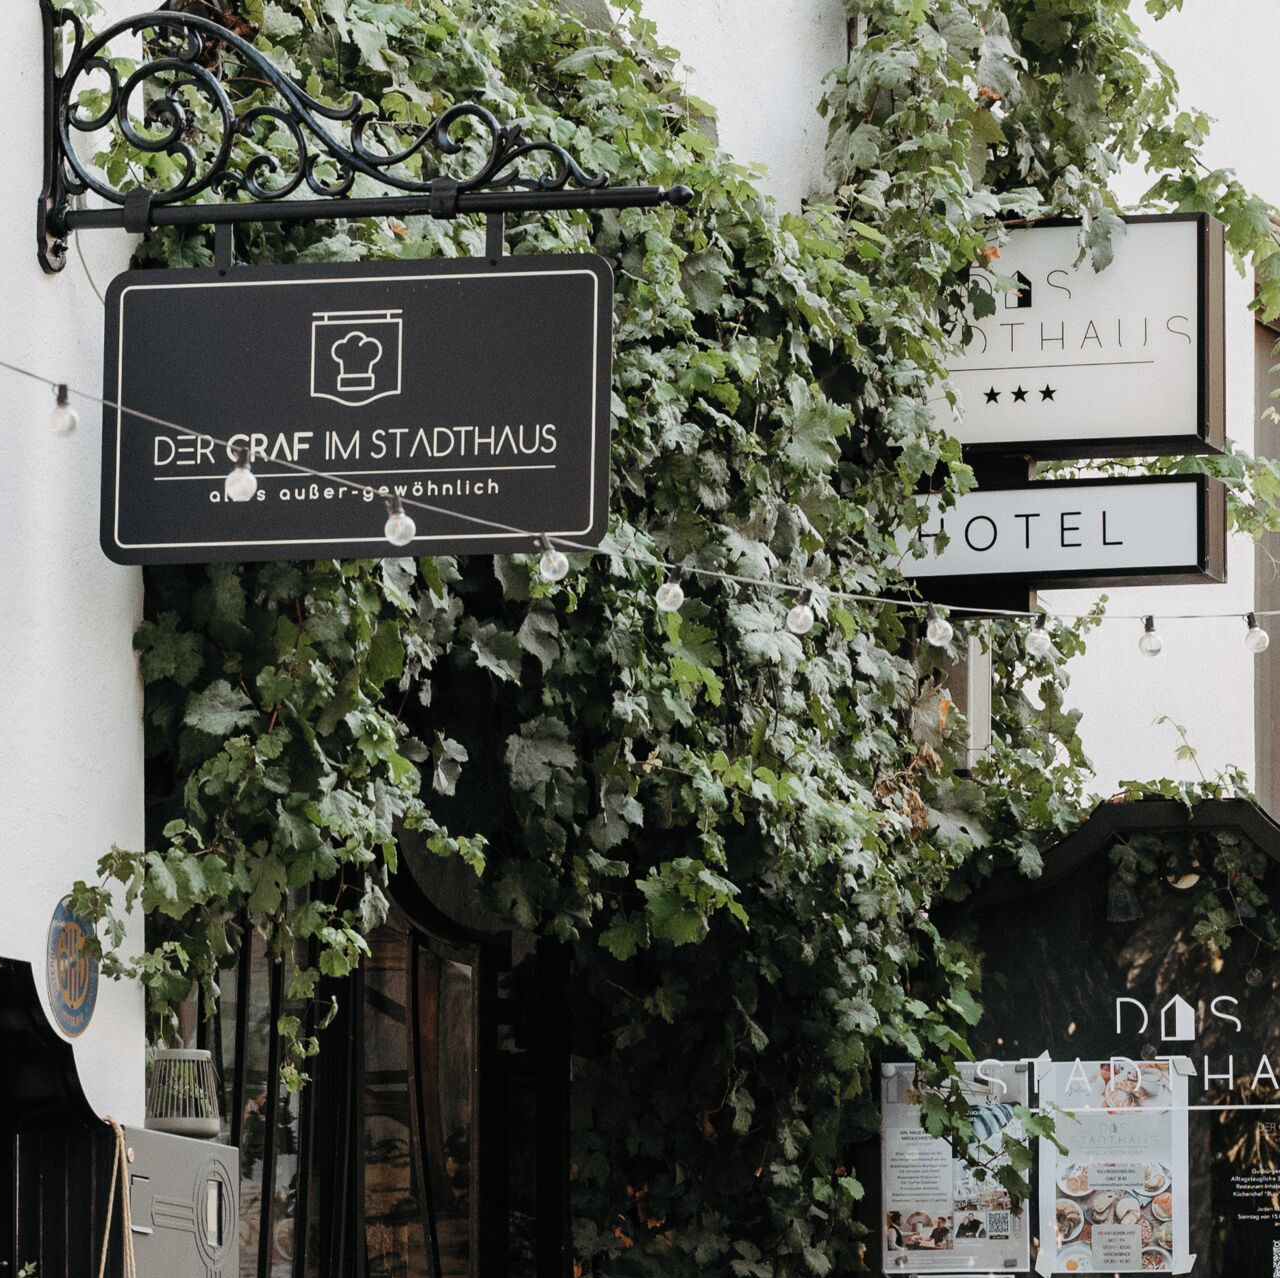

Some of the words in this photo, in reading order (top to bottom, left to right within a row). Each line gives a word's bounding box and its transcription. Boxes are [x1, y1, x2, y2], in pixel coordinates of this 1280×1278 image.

[153, 434, 216, 467] DER
[226, 430, 315, 465] GRAF
[324, 428, 361, 461] IM
[370, 423, 558, 460] STADTHAUS
[209, 485, 266, 503] als
[279, 478, 501, 504] außer-gewöhnlich
